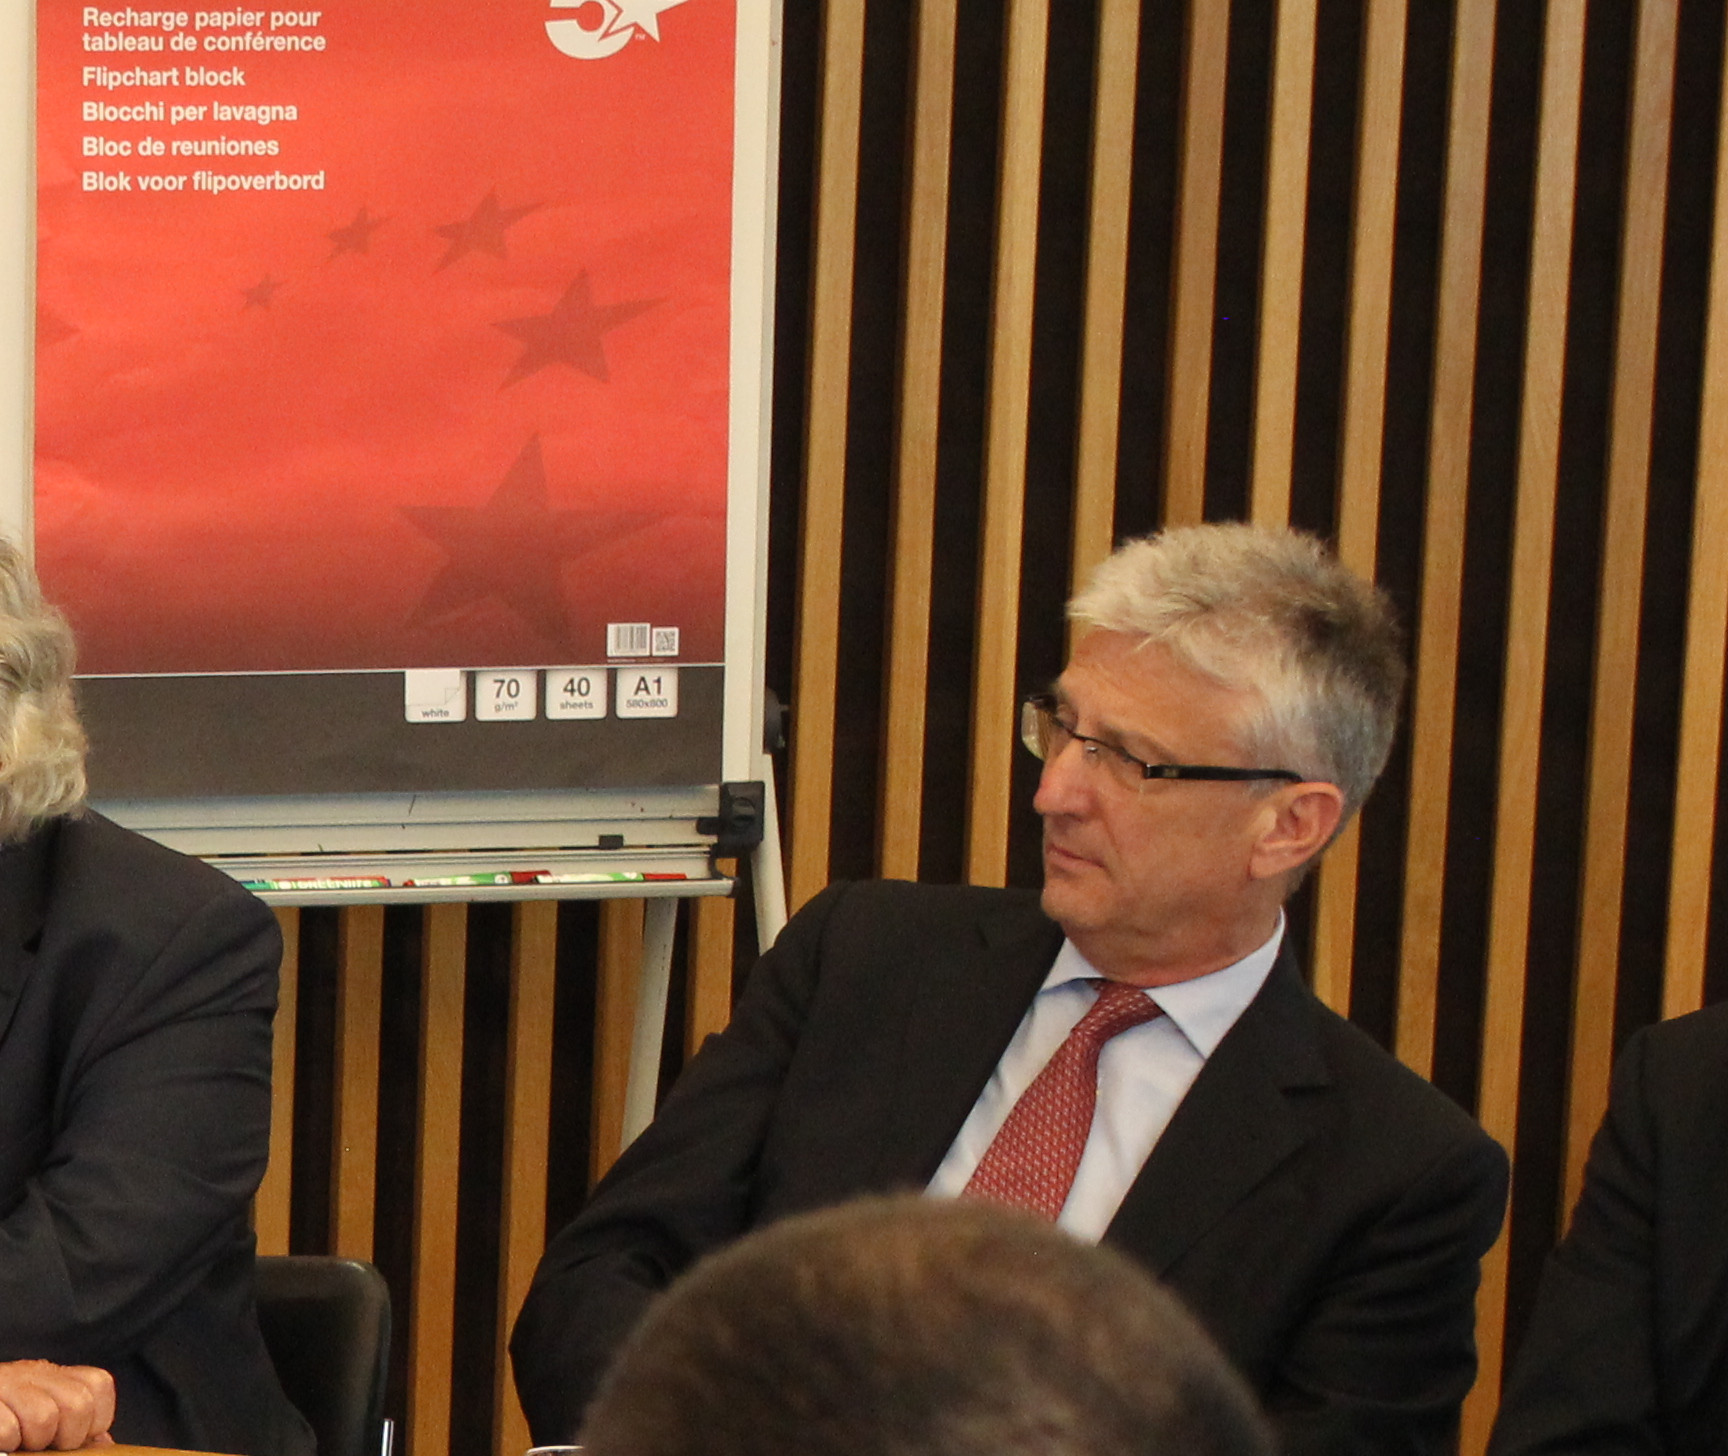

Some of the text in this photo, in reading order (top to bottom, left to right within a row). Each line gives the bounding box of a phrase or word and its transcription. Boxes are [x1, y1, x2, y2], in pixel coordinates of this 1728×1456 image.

[83, 7, 321, 31] Recharge papier pour
[83, 31, 326, 51] tableau de conférence
[83, 66, 245, 90] Flipchart block
[83, 102, 297, 125] Blocchi per lavagna
[83, 136, 279, 156] Bloc de reuniones
[83, 170, 324, 194] Blok voor flipoverbord
[493, 678, 520, 699] 70
[563, 677, 591, 698] 40
[634, 676, 663, 697] A1
[421, 708, 450, 718] white
[559, 699, 594, 711] sheets
